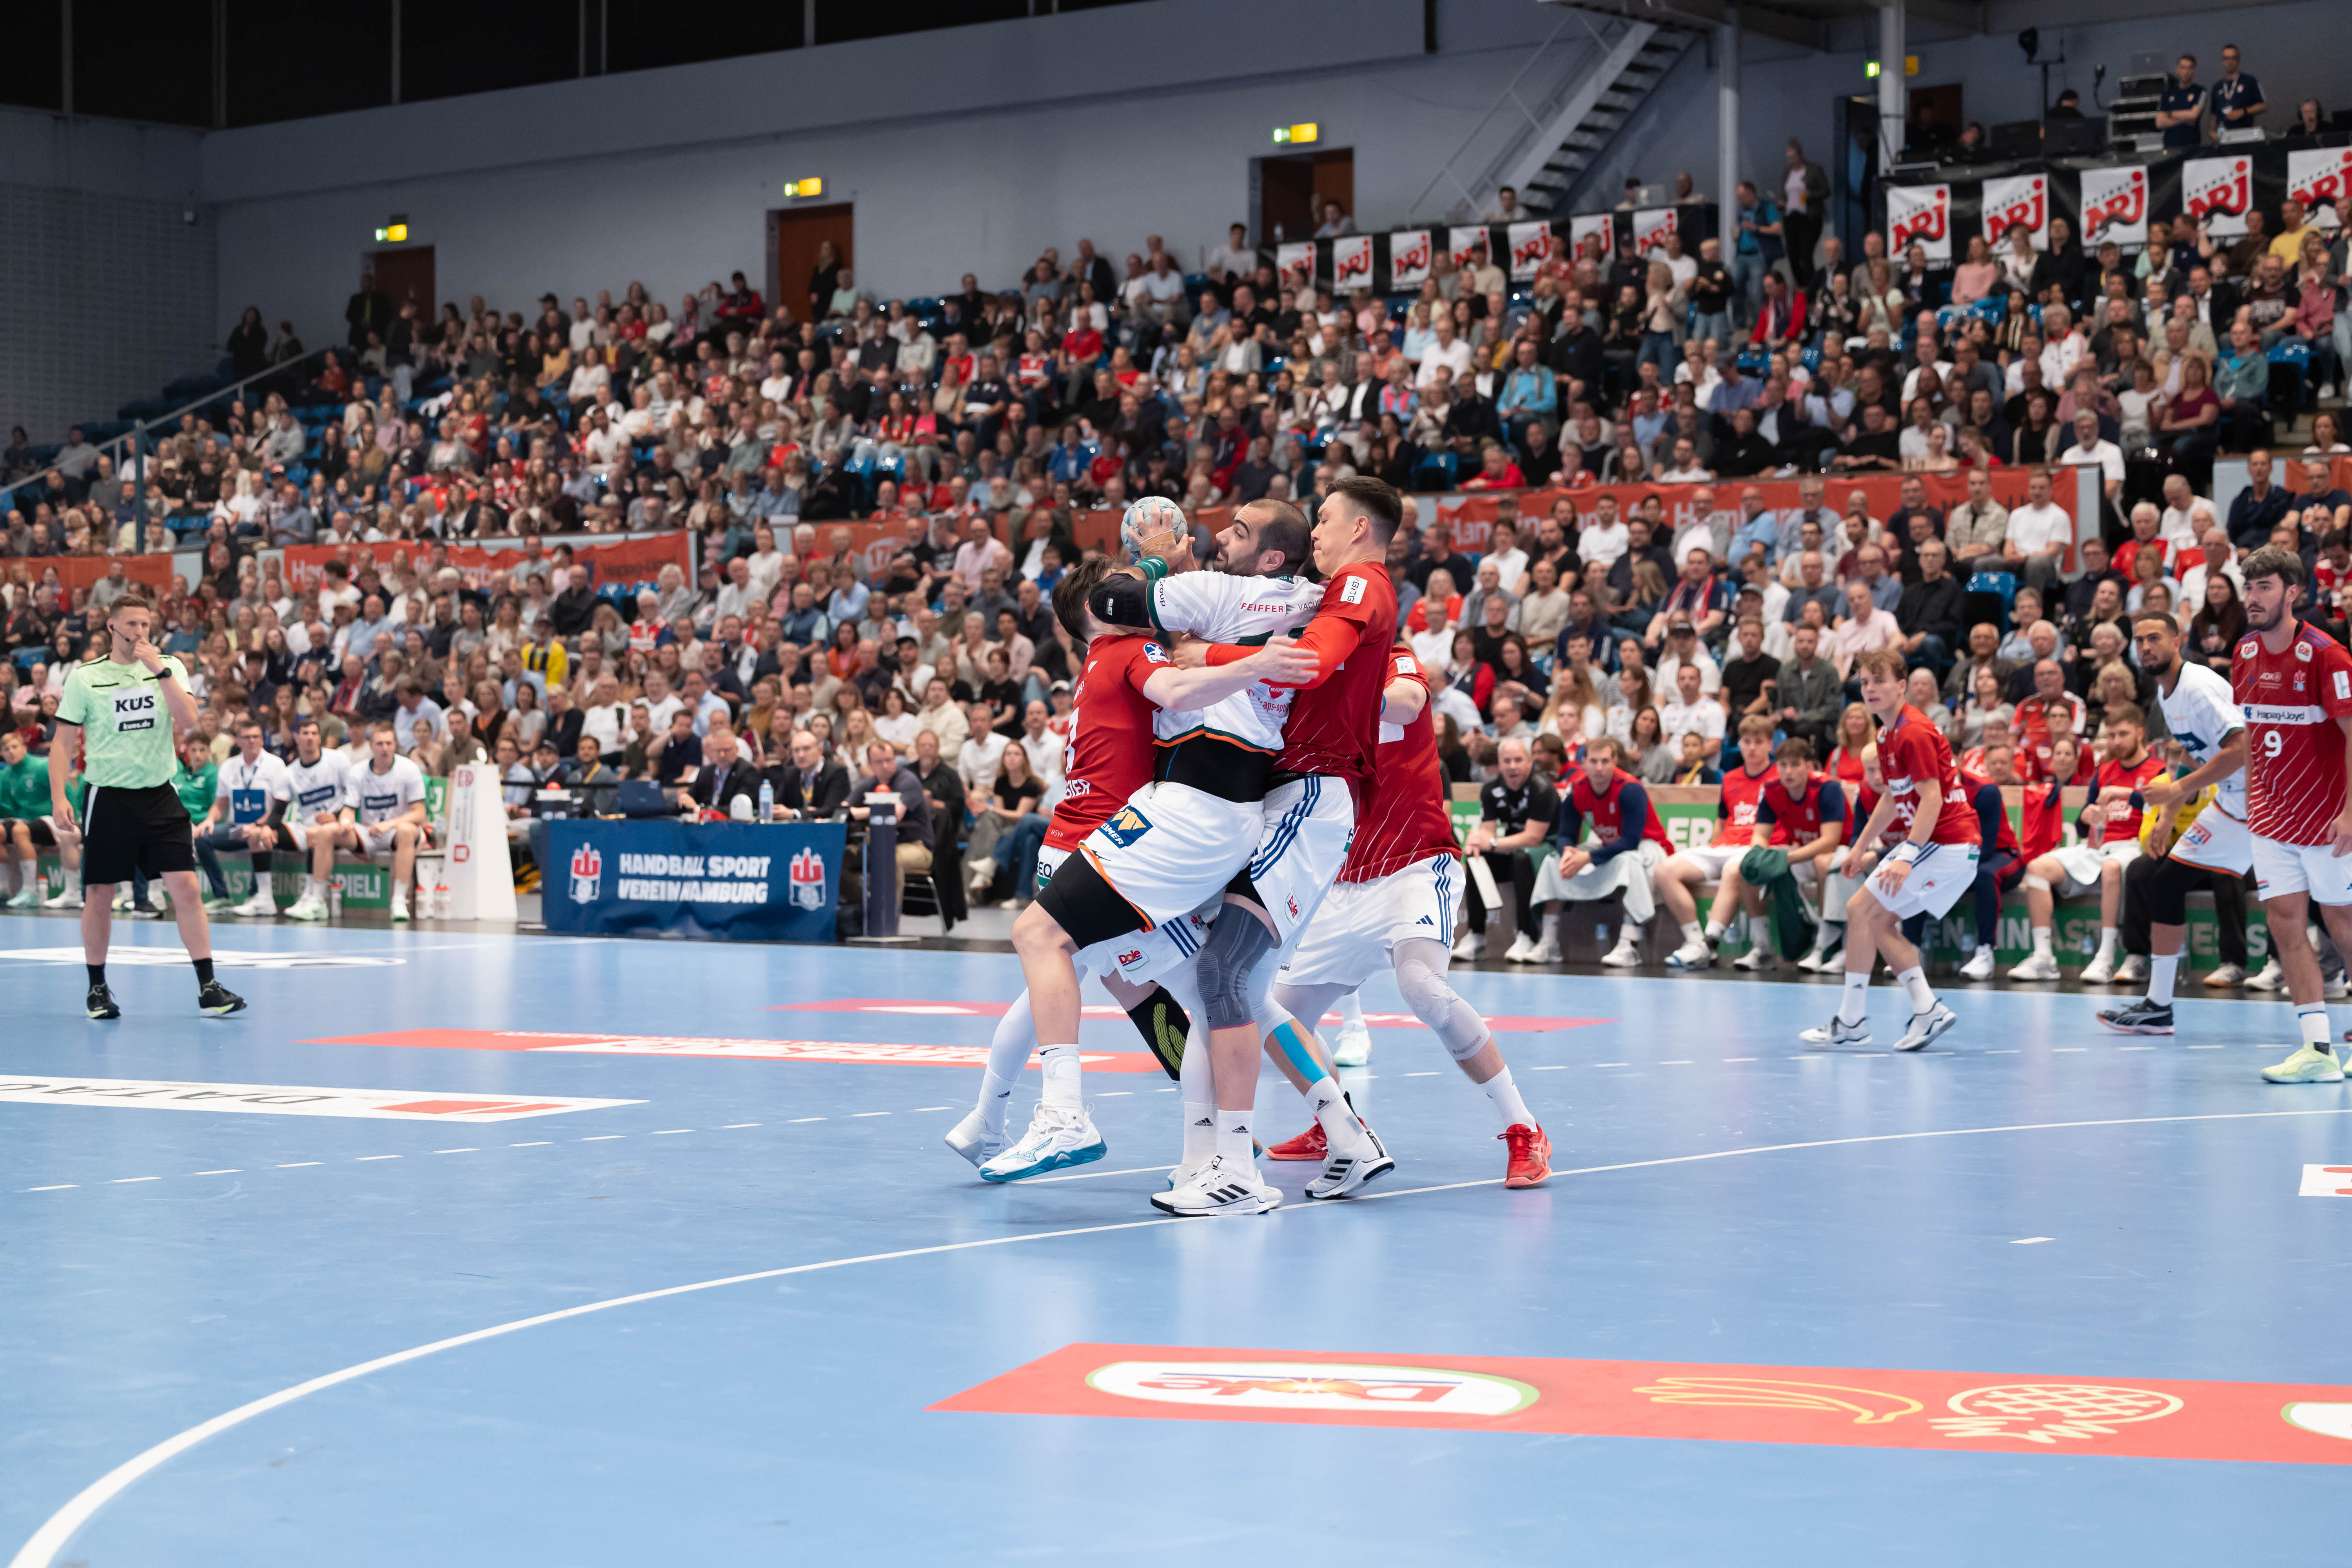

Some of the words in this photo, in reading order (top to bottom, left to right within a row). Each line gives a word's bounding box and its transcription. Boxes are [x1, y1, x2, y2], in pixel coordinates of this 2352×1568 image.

[2257, 709, 2305, 722] Hapag-Lloyd
[2264, 730, 2282, 758] 9
[1050, 829, 1063, 838] HSVH
[619, 853, 705, 877] HANDBALL
[708, 855, 771, 878] SPORT
[1037, 862, 1052, 880] EQ
[332, 873, 381, 899] PIEL!
[618, 878, 681, 902] VEREIN
[679, 880, 769, 904] HAMBURG
[1118, 949, 1141, 965] Dole
